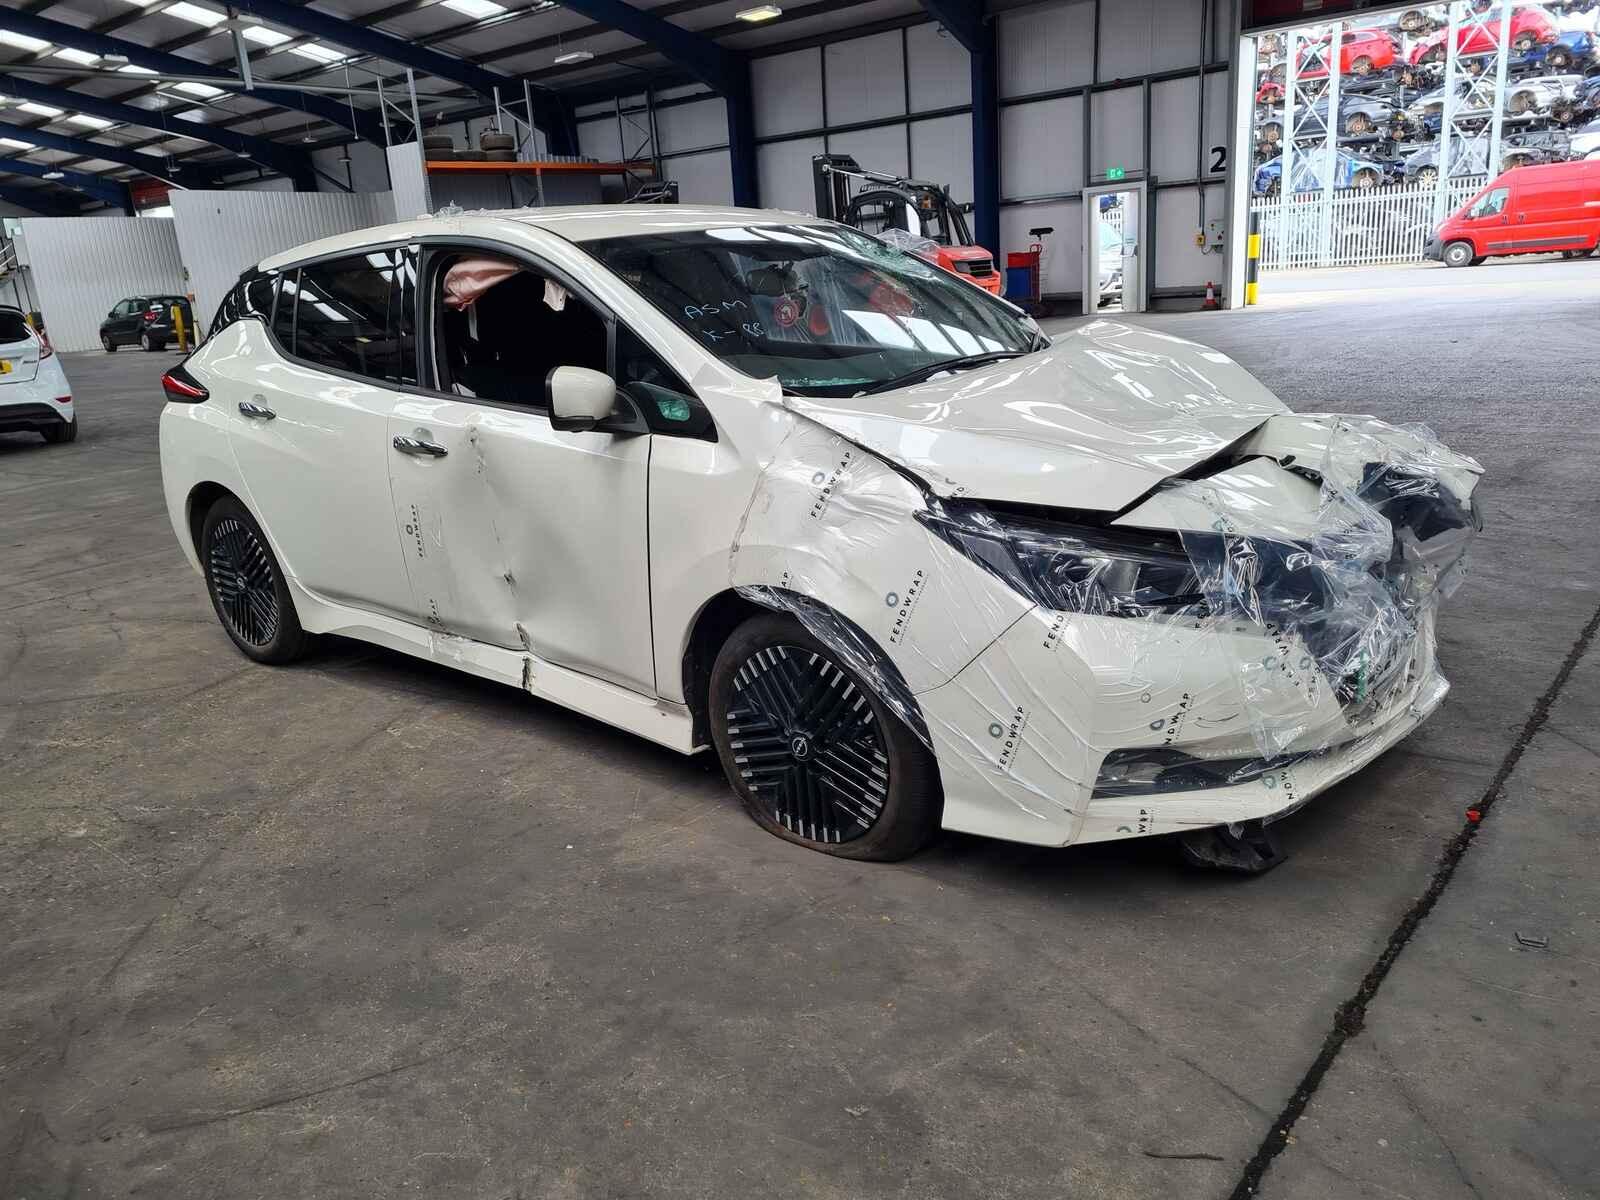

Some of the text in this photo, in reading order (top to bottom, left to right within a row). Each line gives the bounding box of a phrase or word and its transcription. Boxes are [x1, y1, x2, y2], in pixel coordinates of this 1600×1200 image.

[1210, 146, 1226, 173] 2
[684, 300, 748, 320] ASM
[889, 569, 923, 644] FENDWRAP
[1043, 614, 1064, 649] FEND
[1266, 623, 1300, 687] FENWRAP
[1162, 692, 1189, 746] NDWAP
